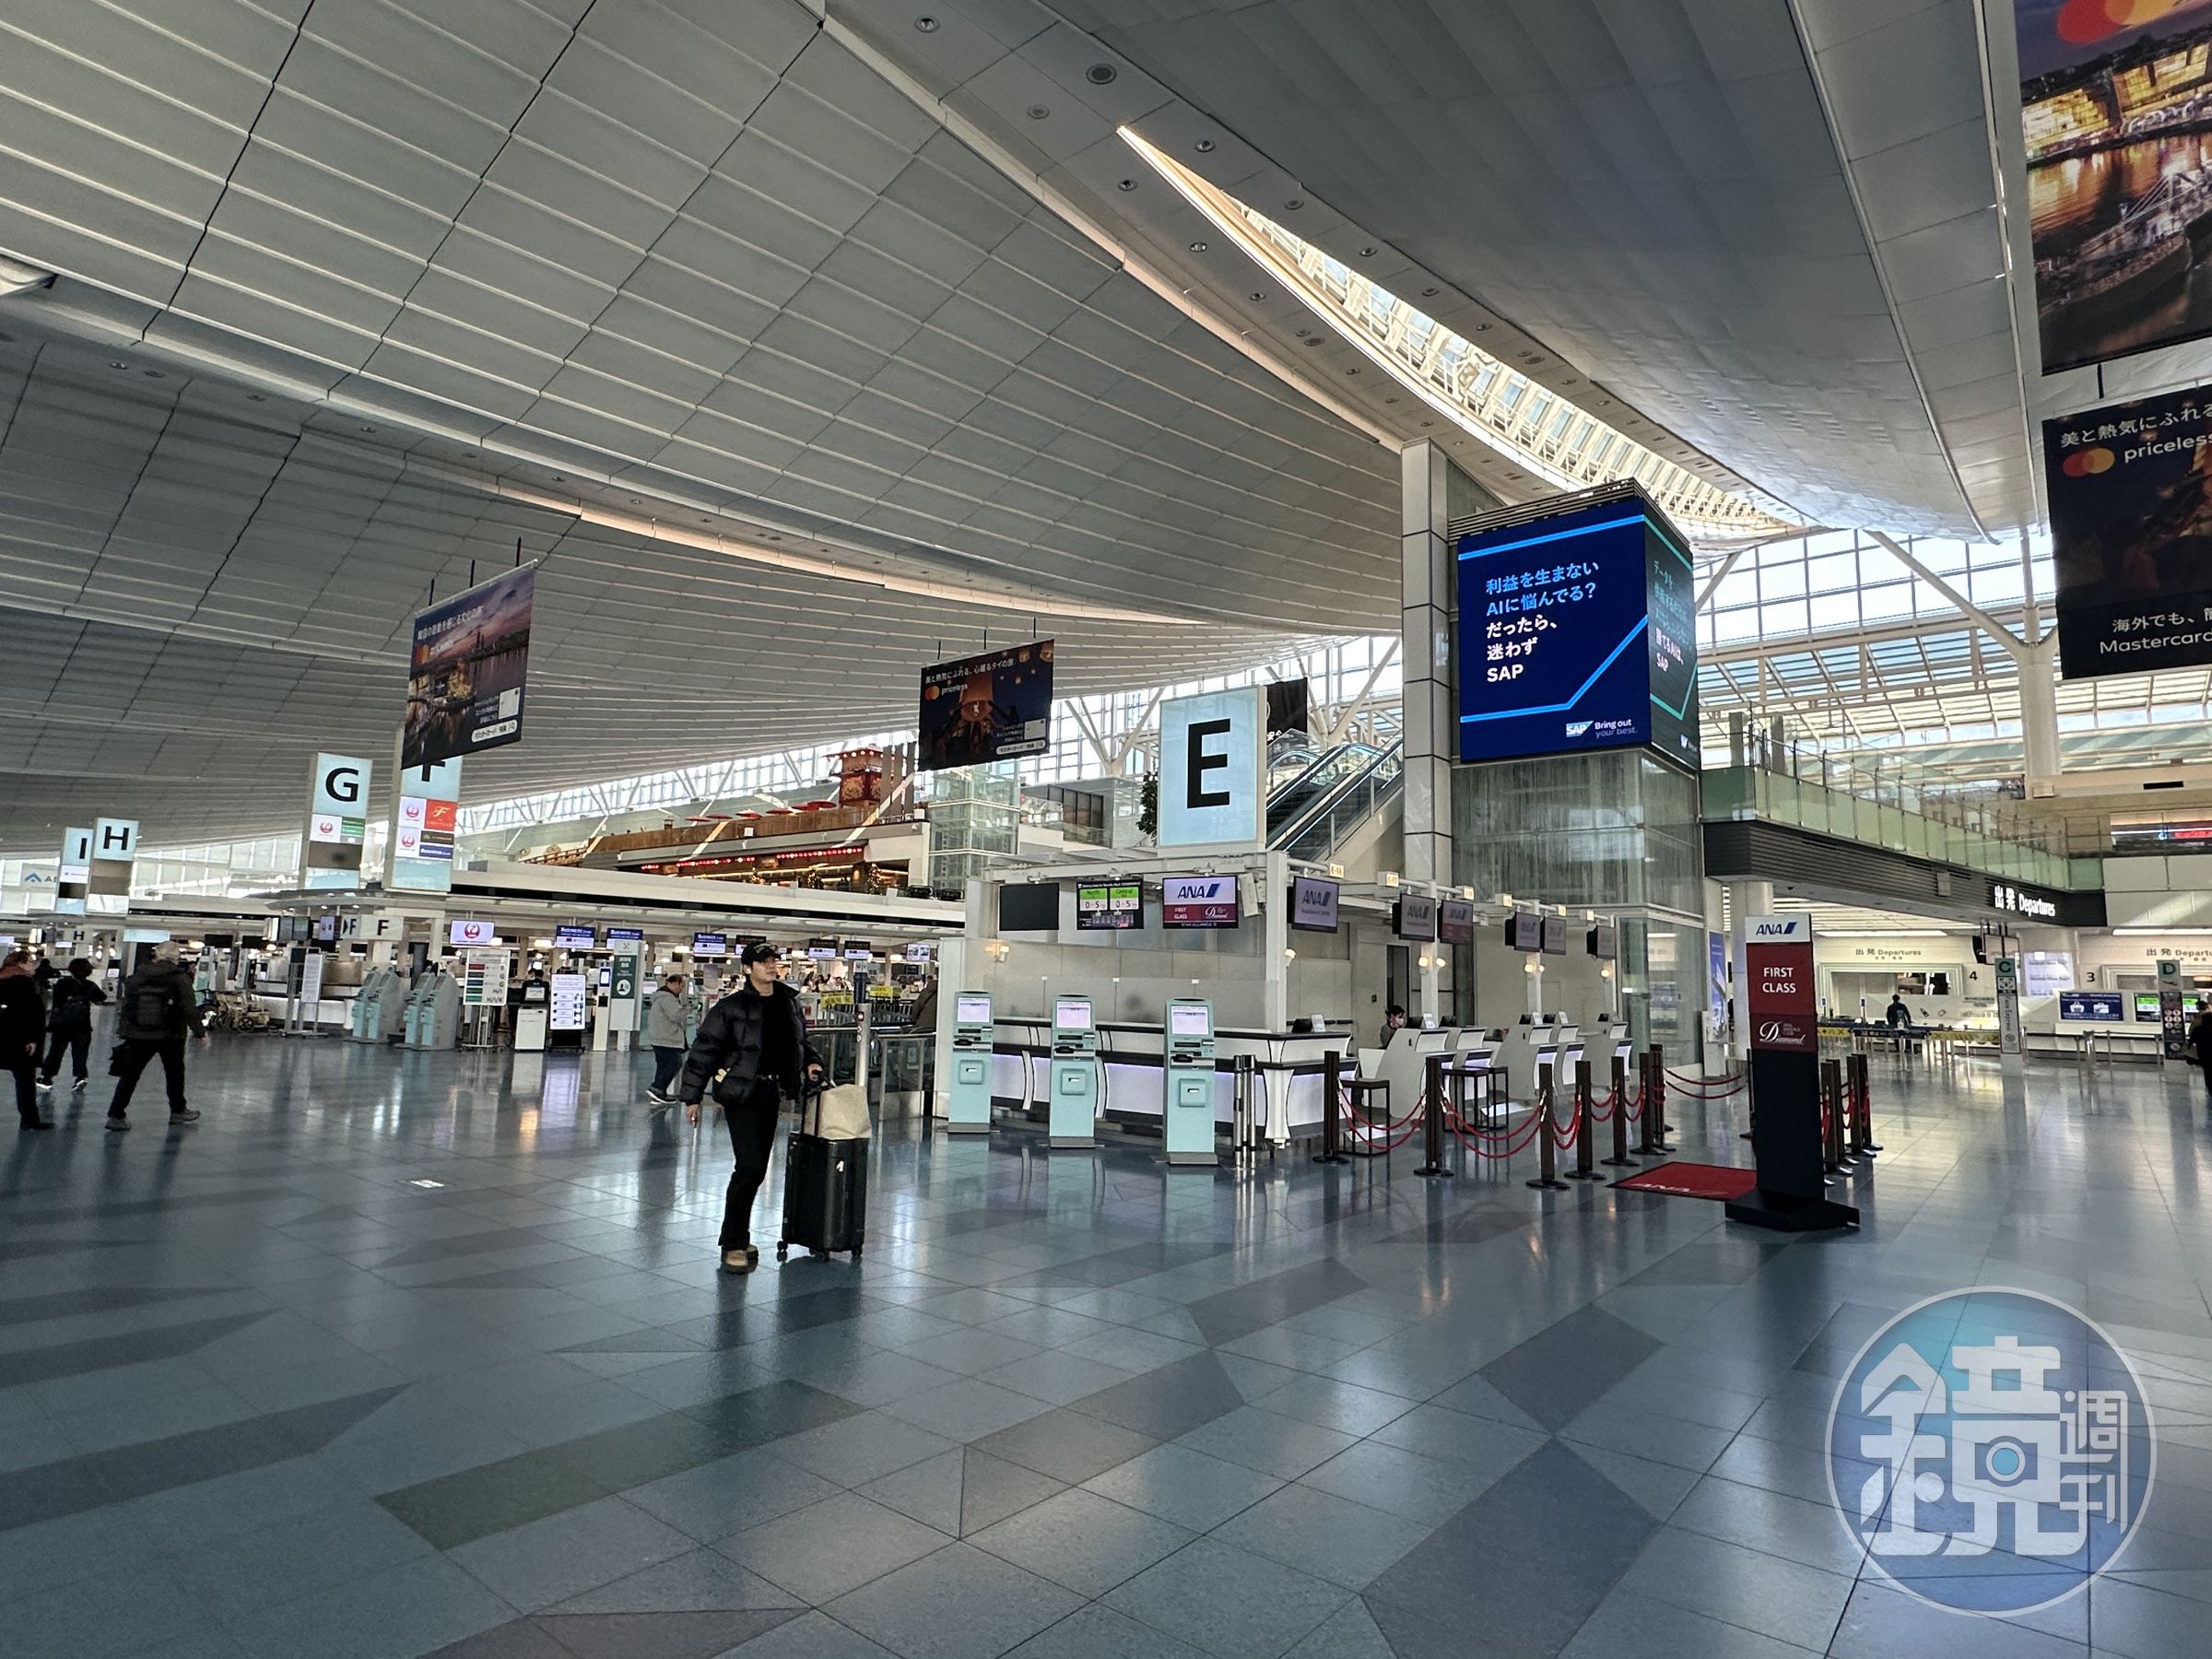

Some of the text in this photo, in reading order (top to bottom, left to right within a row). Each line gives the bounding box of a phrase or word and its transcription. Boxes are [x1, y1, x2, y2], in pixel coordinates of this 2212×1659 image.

[2060, 403, 2212, 448] 美と熱気にふれる
[1485, 561, 1600, 595] 利益を生まない
[1486, 582, 1597, 617] AIに悩んでる？
[1486, 614, 1558, 639] だったら、
[1487, 636, 1538, 662] 迷わず
[1487, 664, 1524, 683] SAP
[1594, 719, 1632, 731] Bring out
[1595, 726, 1638, 738] your best.
[1187, 718, 1230, 808] E
[325, 767, 359, 802] G
[103, 826, 130, 851] H
[79, 838, 88, 859] I
[1178, 886, 1206, 899] ANA
[1302, 890, 1323, 906] ANA
[1994, 885, 2056, 917] 出発 Departures
[376, 919, 390, 935] F
[1756, 924, 1783, 935] ANA
[74, 931, 85, 941] H
[1877, 948, 1922, 958] Departures
[1763, 967, 1794, 978] FIRST
[1998, 961, 2012, 974] C
[2162, 963, 2176, 975] D
[1969, 971, 1978, 981] 4
[2087, 971, 2096, 982] 3
[1761, 982, 1797, 994] CLASS
